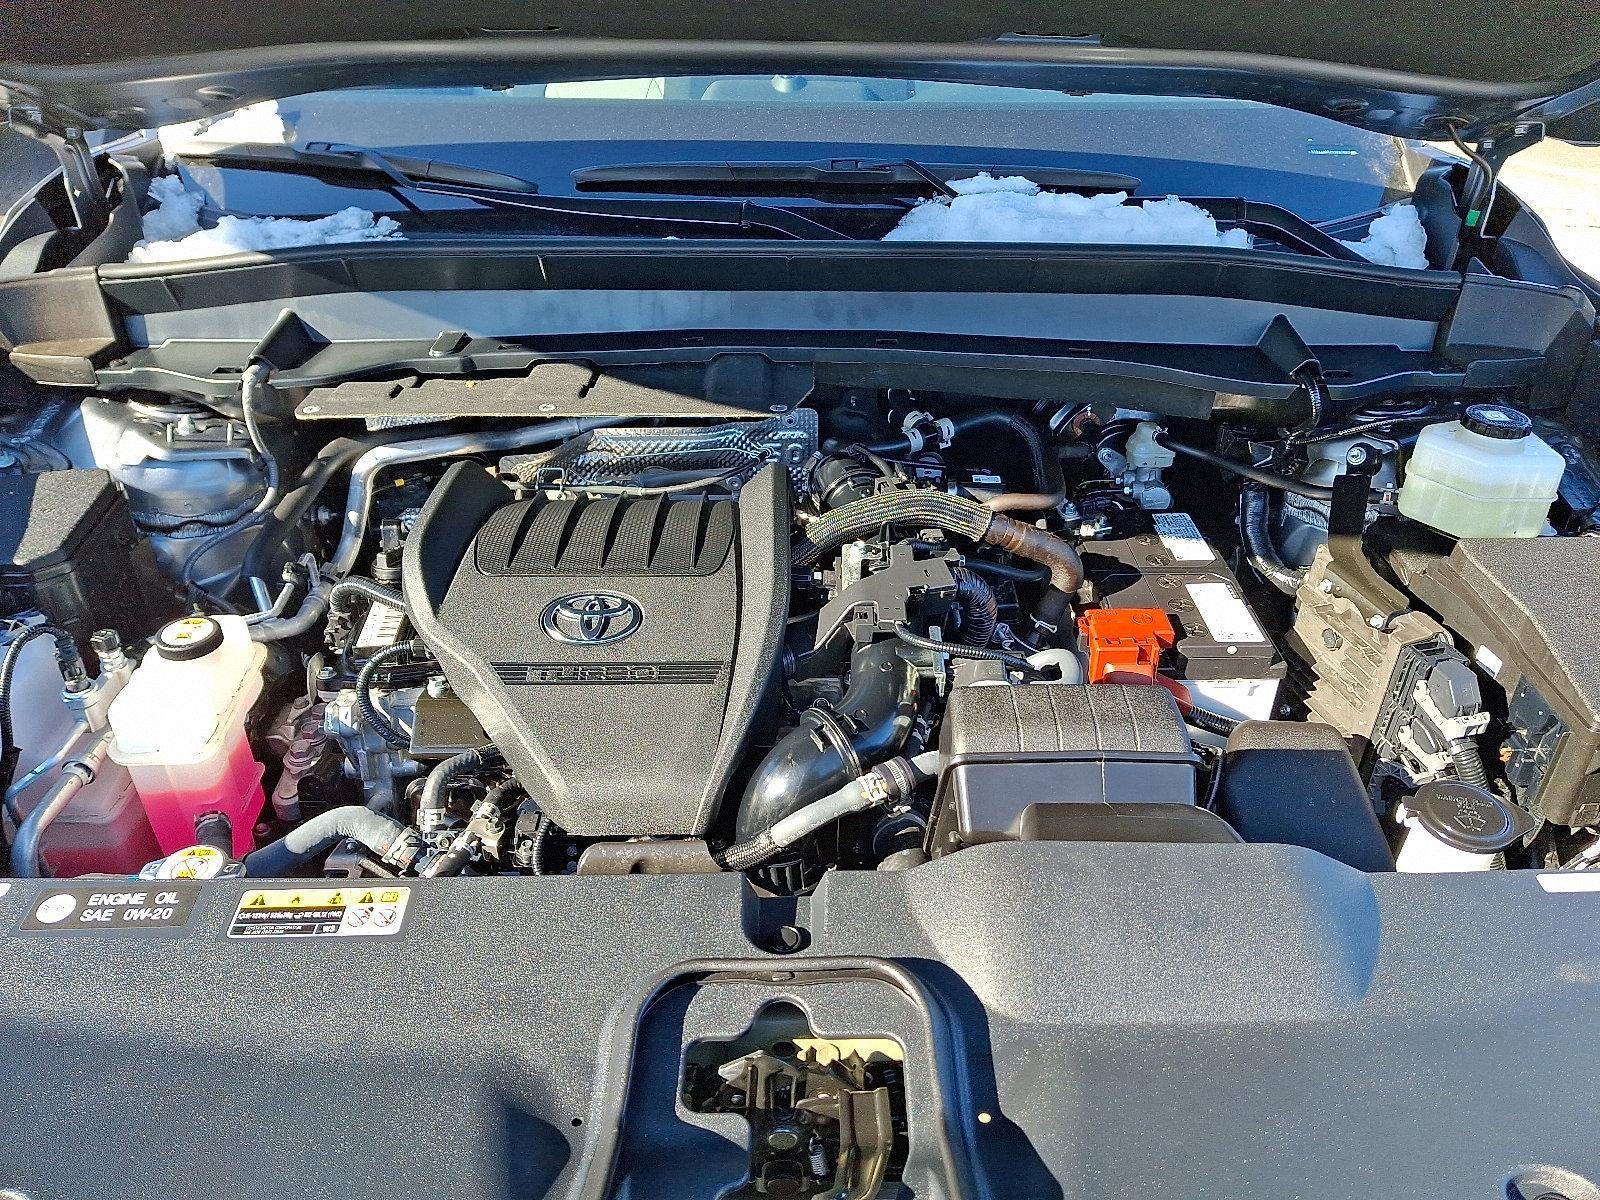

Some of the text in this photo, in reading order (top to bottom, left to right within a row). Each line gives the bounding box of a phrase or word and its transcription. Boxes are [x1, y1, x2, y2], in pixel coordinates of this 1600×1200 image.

[87, 891, 179, 906] ENGINE OIL
[79, 907, 173, 922] SAE 0W-20
